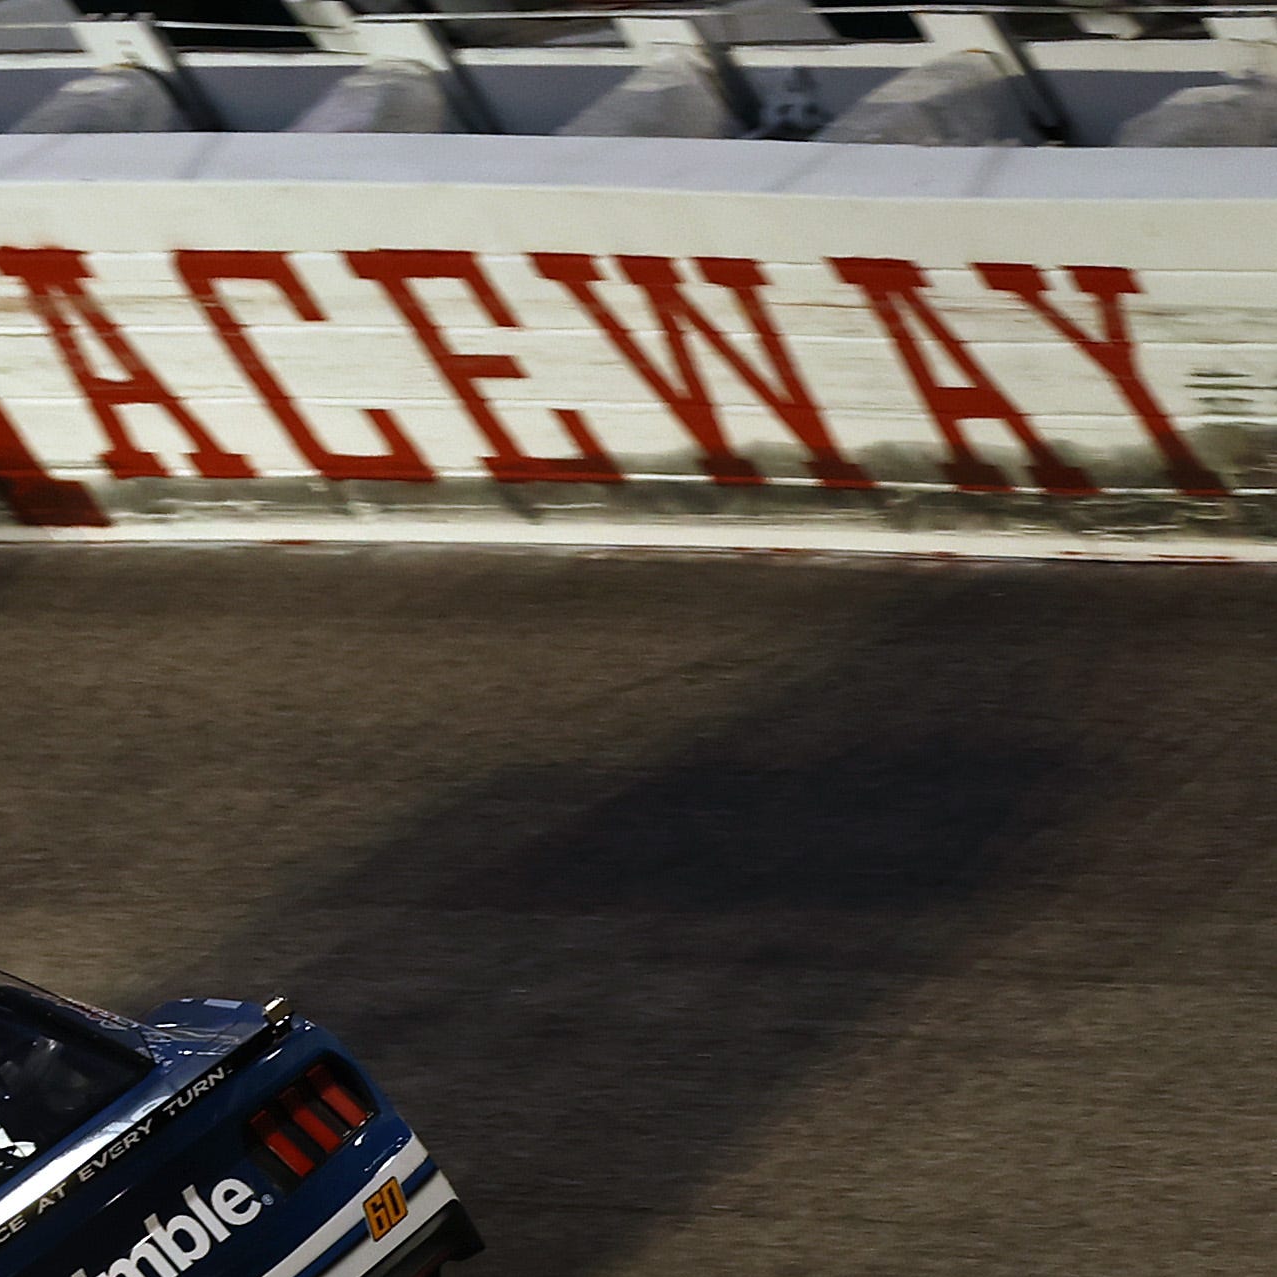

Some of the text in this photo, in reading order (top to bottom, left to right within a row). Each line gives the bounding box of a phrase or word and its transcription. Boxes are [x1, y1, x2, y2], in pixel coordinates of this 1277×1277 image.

[35, 1181, 69, 1216] AT
[78, 1120, 155, 1183] EVERY
[363, 1178, 408, 1242] 60
